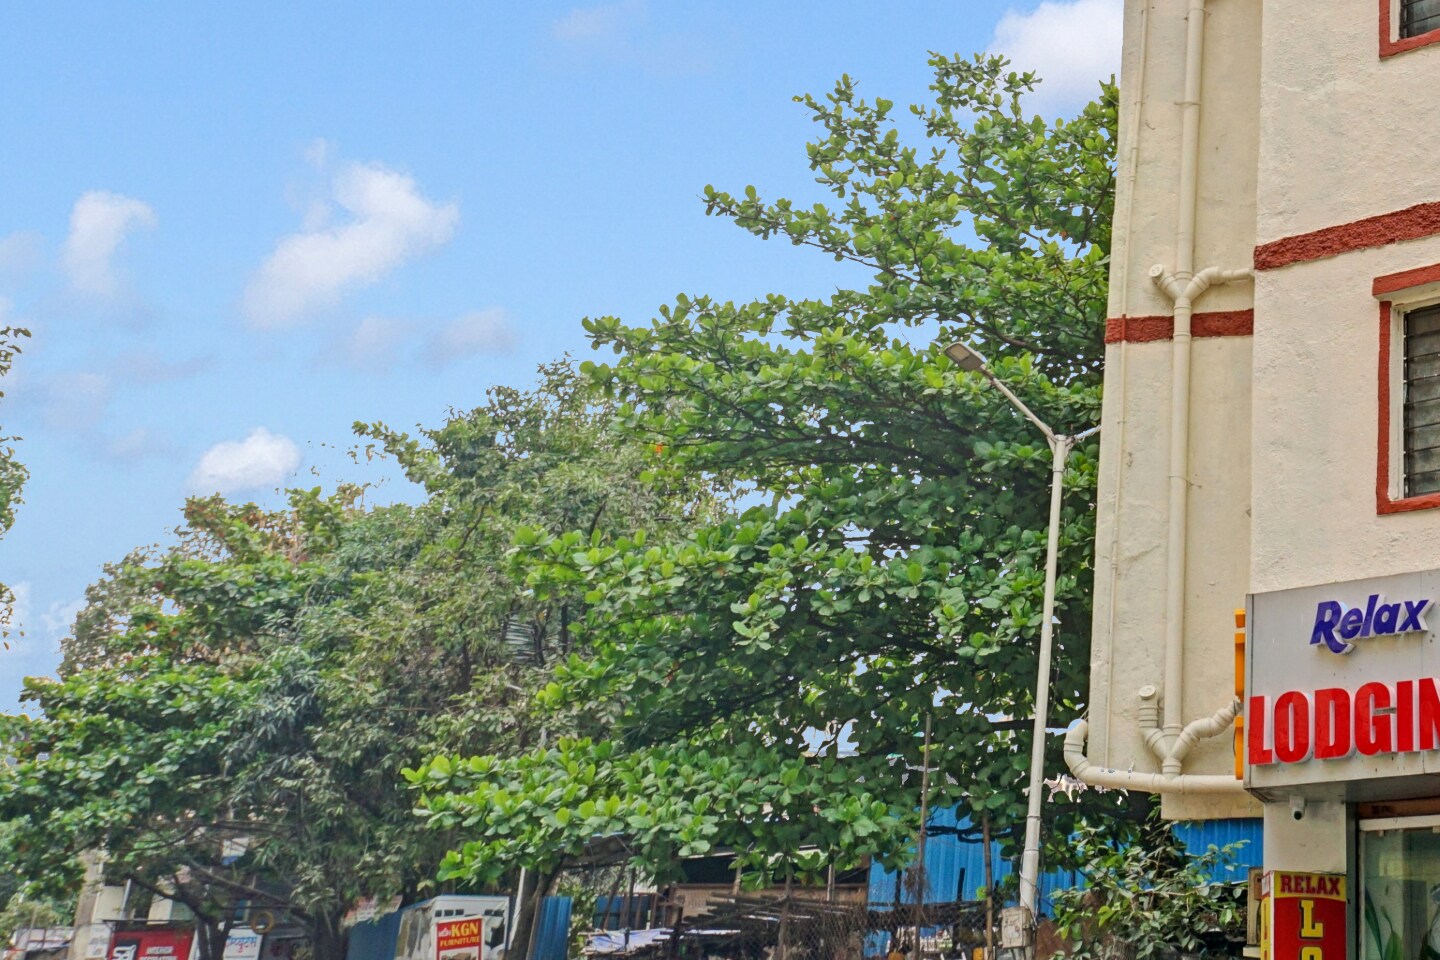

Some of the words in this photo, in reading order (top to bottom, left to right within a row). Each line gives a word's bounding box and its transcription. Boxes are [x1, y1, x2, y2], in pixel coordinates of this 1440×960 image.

[1310, 594, 1434, 655] Relax
[1280, 874, 1341, 896] RELAX
[451, 922, 478, 937] KGN
[440, 936, 479, 947] FURNITURE
